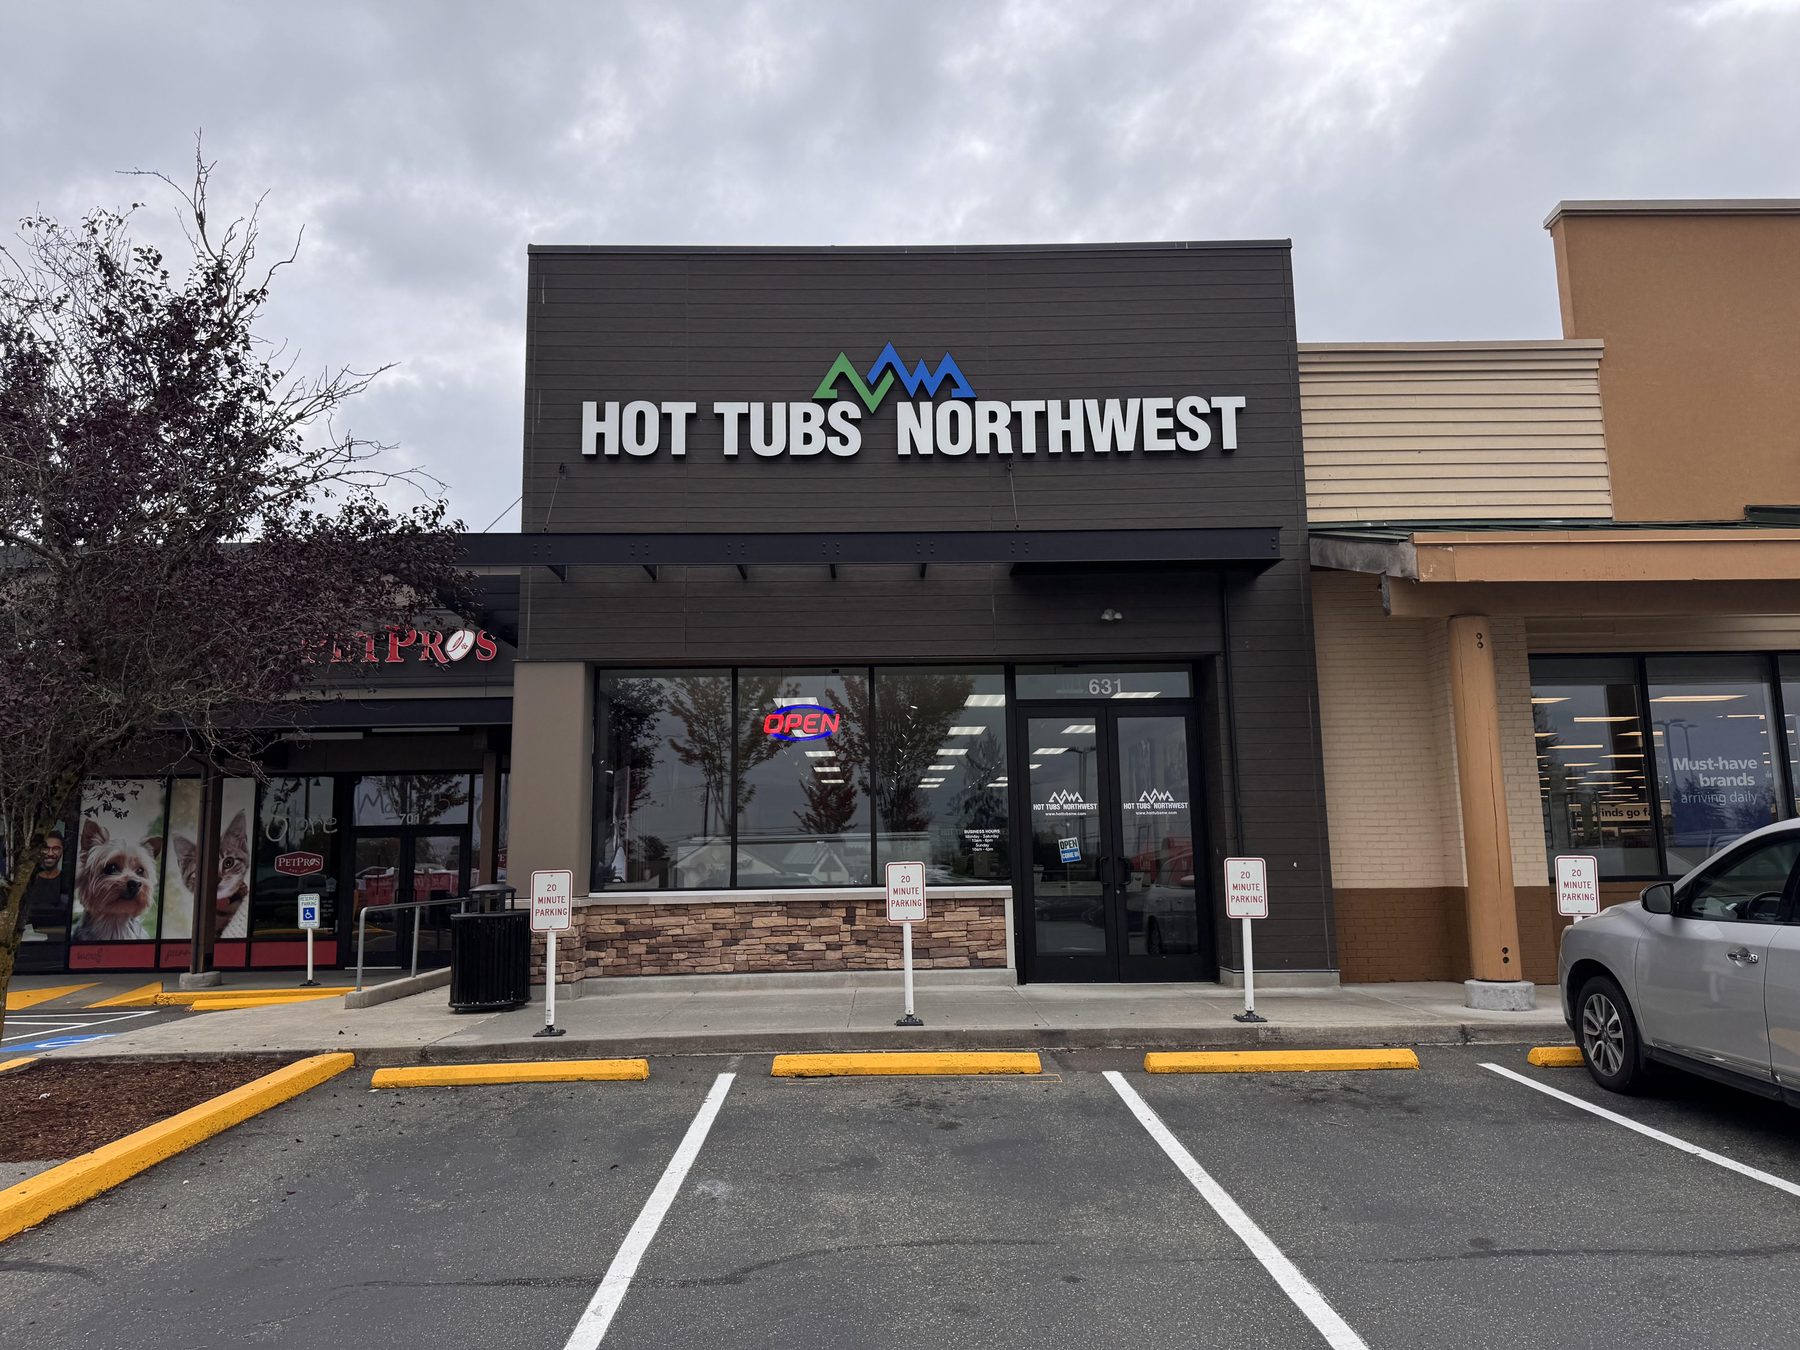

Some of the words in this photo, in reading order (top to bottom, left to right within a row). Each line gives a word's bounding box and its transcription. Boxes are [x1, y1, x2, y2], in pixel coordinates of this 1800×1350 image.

[582, 401, 696, 456] HOT
[714, 401, 862, 457] TUBS
[897, 396, 1246, 456] NORTHWEST
[1089, 679, 1121, 694] 631
[763, 713, 840, 734] OPEN
[1672, 757, 1758, 771] Must-have
[1699, 773, 1756, 787] brands
[1681, 791, 1727, 806] arriving
[1729, 790, 1758, 805] daily
[400, 813, 420, 825] 701
[1626, 809, 1640, 819] go
[1060, 839, 1078, 849] OPEN
[1240, 871, 1250, 879] 20
[1572, 869, 1582, 877] 20
[1232, 883, 1260, 891] MINUTE
[1563, 881, 1592, 889] MINUTE
[892, 887, 920, 895] MINUTE
[538, 896, 566, 904] MINUTE
[1562, 893, 1595, 901] PARKING
[535, 908, 568, 916] PARKING
